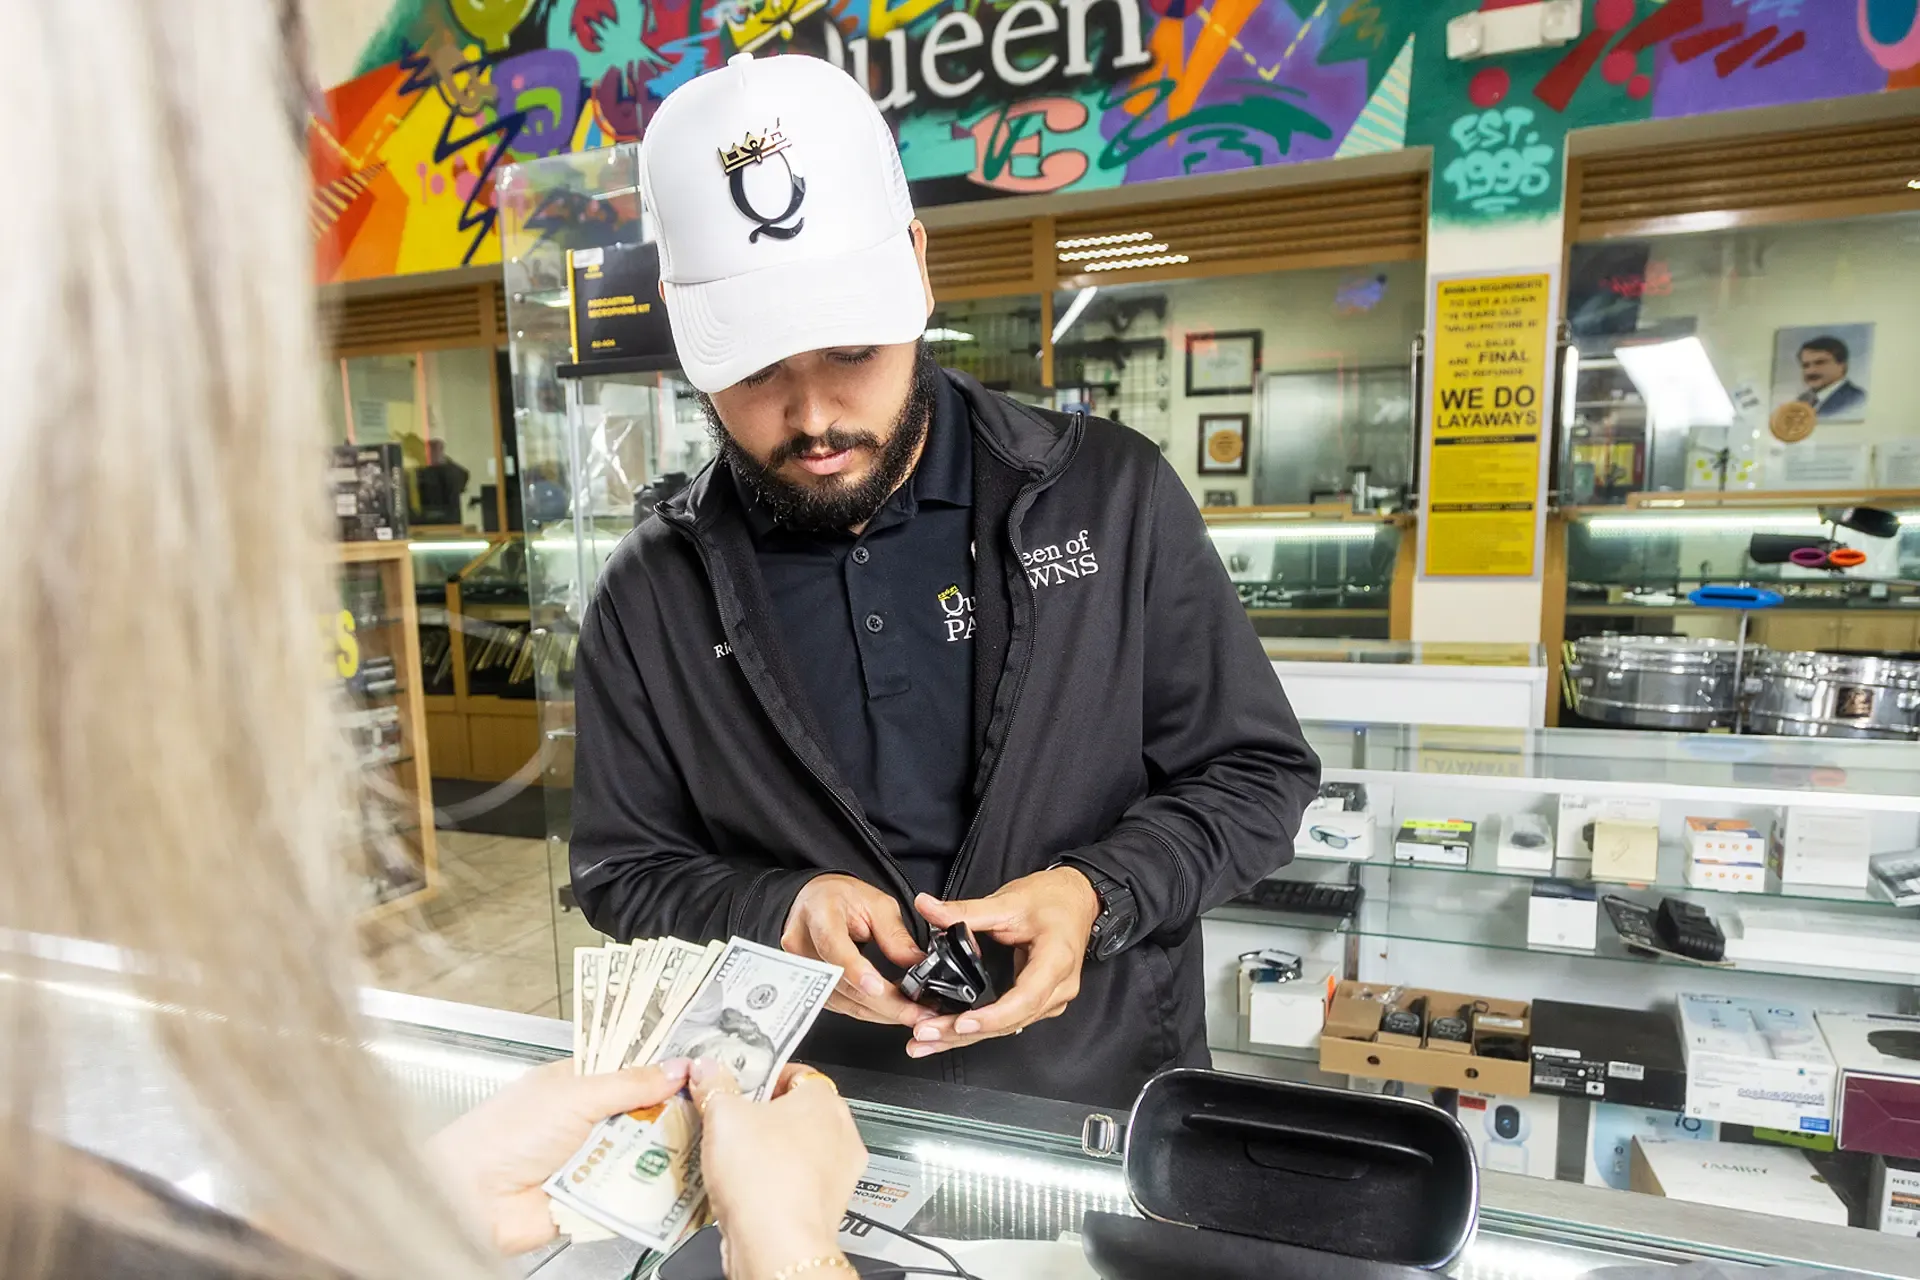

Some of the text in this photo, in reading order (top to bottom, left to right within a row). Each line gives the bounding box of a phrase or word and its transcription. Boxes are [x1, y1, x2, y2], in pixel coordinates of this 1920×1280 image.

[823, 0, 1152, 112] ueen
[1451, 105, 1540, 152] EST.
[1442, 144, 1556, 201] 1995
[1478, 350, 1531, 365] FINAL
[1441, 384, 1536, 411] WE DO
[1436, 409, 1538, 430] LAYAWAYS
[1065, 529, 1091, 555] of
